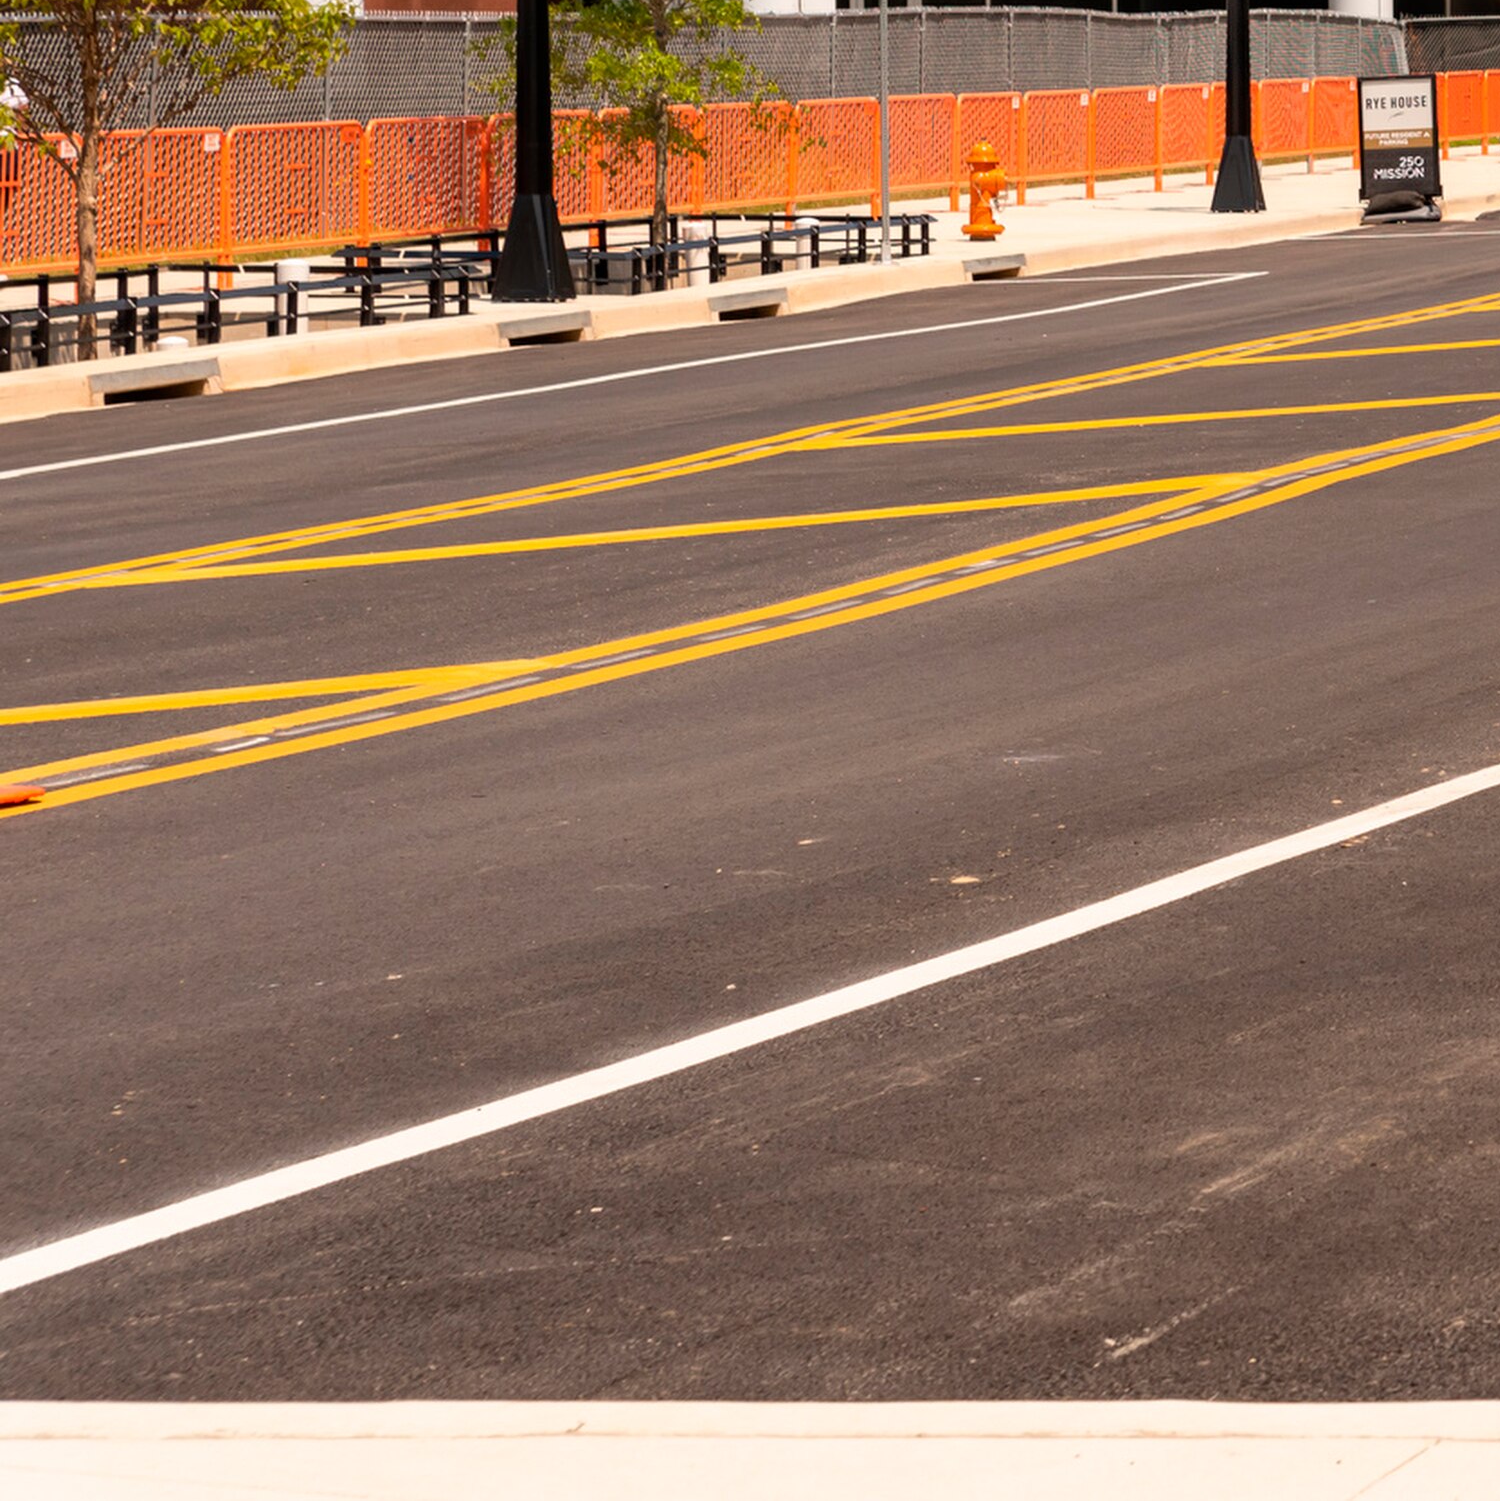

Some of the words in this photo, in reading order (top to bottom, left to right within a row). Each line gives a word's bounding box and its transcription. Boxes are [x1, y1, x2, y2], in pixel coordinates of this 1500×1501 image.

[1365, 97, 1387, 110] RYE
[1390, 95, 1428, 109] HOUSE
[1364, 132, 1390, 140] FUTURE
[1390, 130, 1423, 139] RESIDENT
[1399, 155, 1424, 168] 250
[1373, 167, 1425, 180] MISSION
